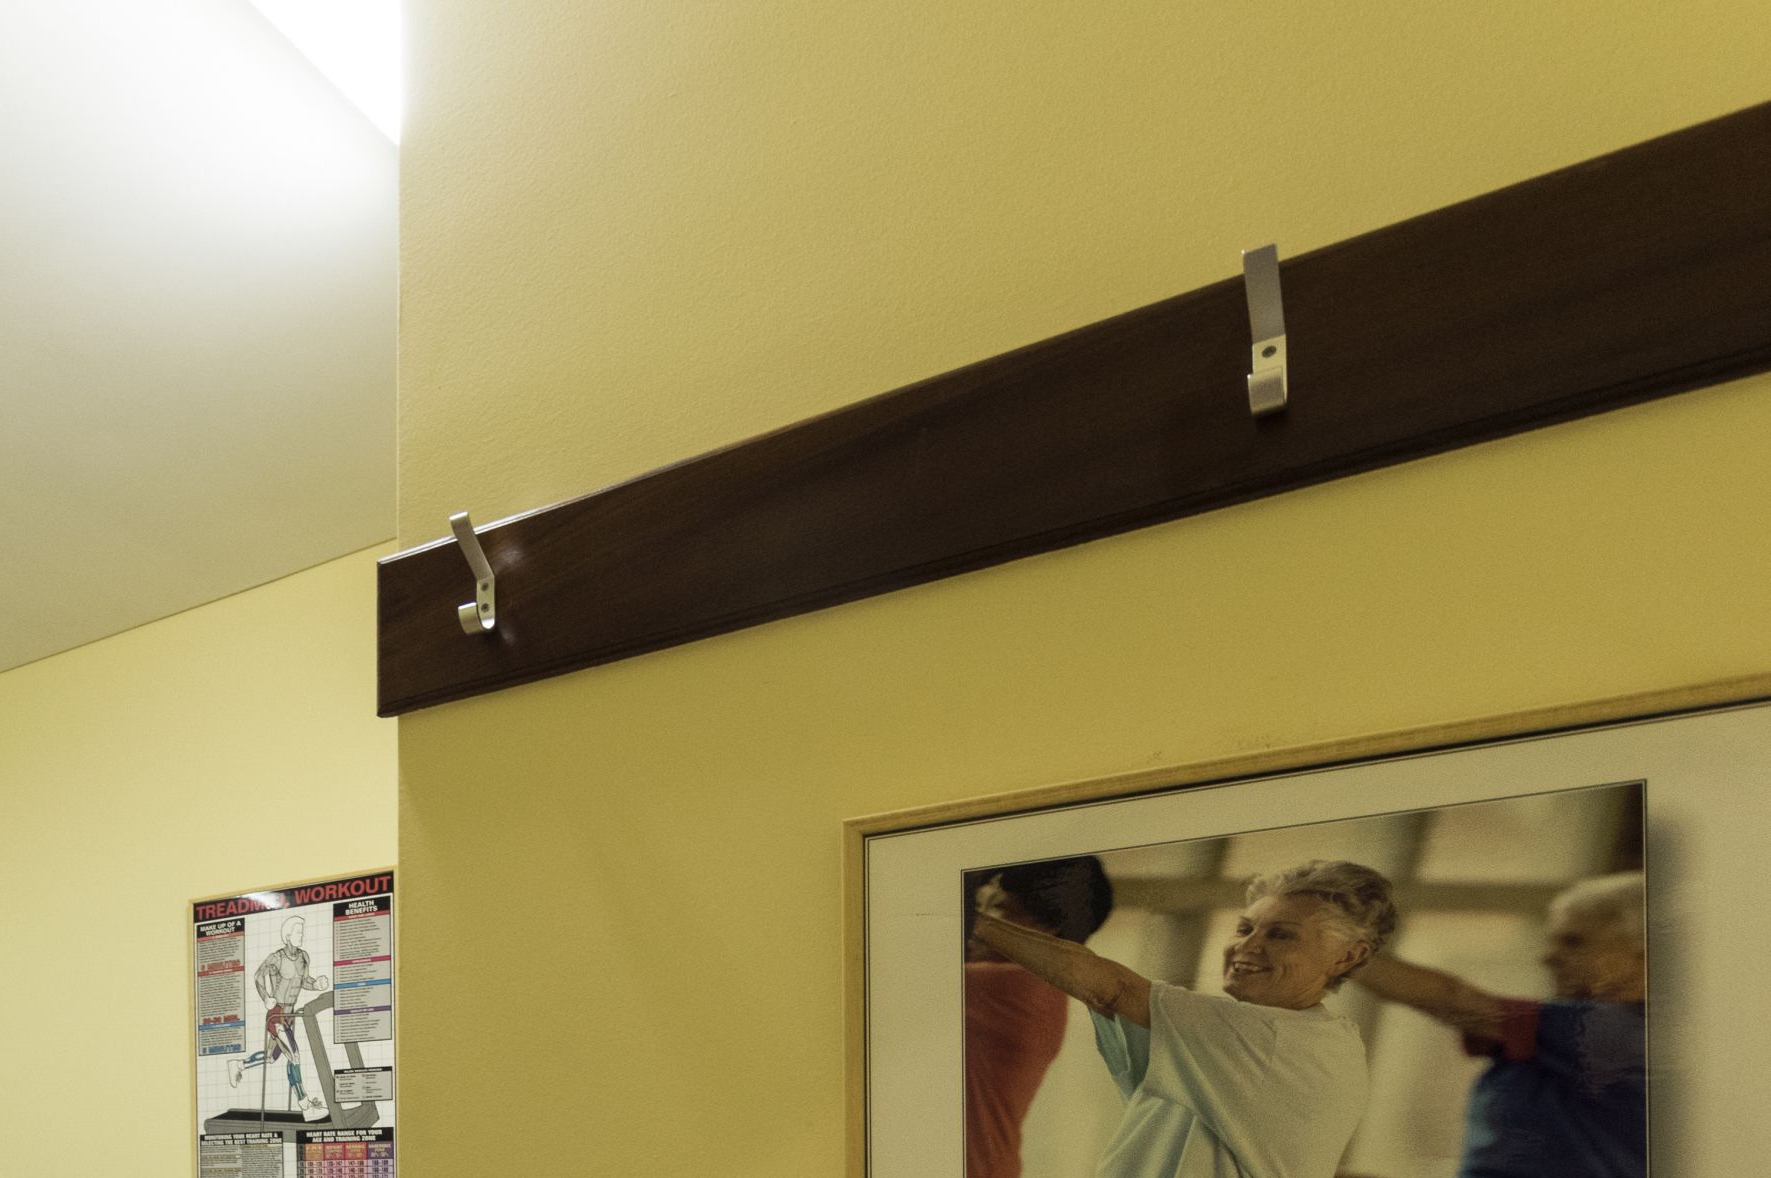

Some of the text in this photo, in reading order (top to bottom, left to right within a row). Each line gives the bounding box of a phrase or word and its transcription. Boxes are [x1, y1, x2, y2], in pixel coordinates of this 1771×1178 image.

[294, 876, 392, 906] WORKOUT
[348, 900, 375, 909] HEALTH
[345, 906, 378, 916] BENEFITS
